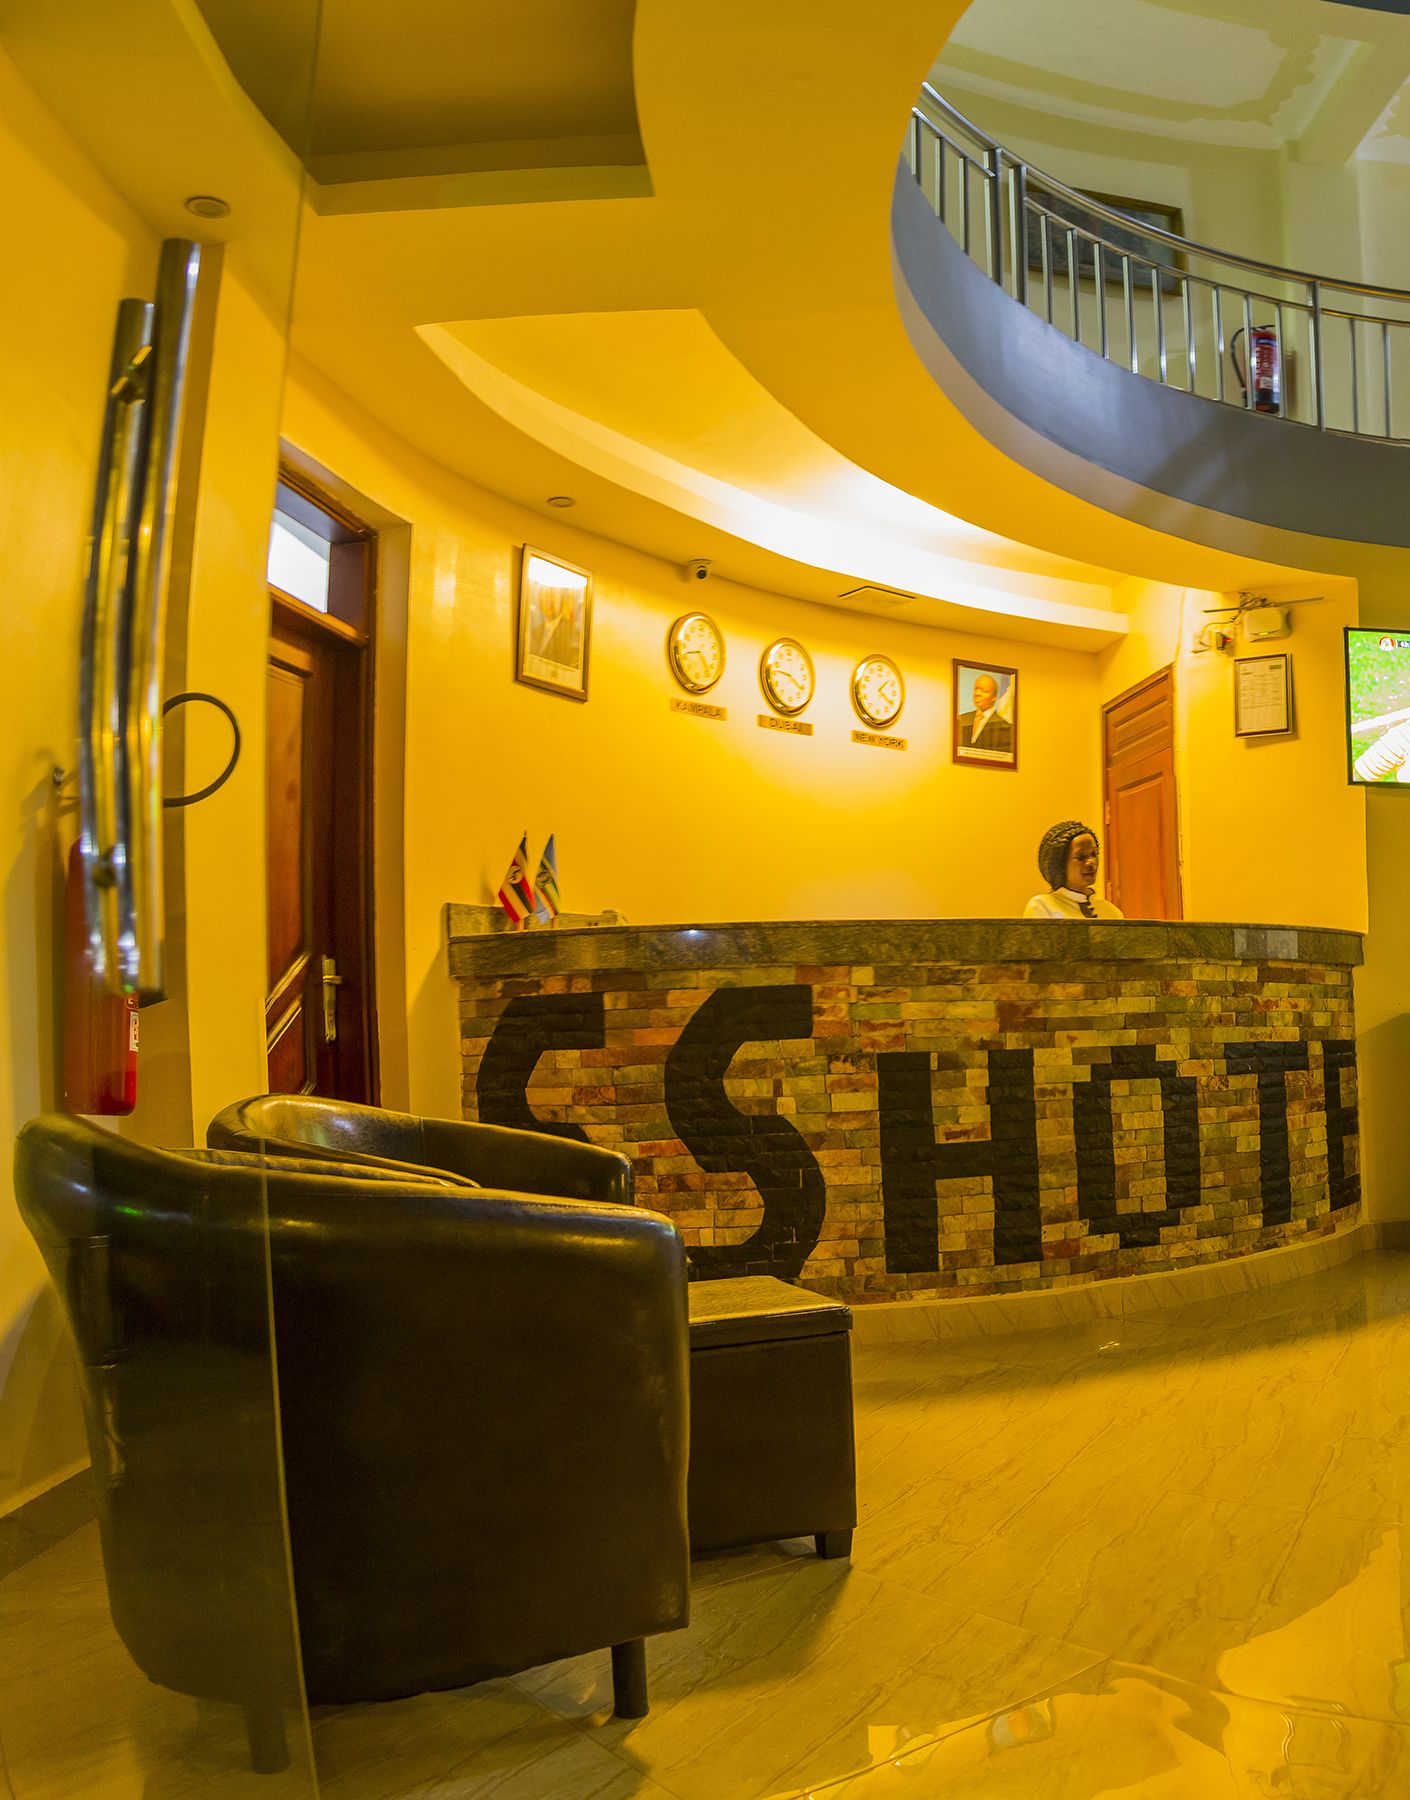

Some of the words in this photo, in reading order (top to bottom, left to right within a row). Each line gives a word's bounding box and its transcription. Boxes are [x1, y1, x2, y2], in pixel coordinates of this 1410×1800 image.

[676, 701, 721, 717] KAMPALA
[768, 717, 803, 733] DUBAI
[855, 732, 875, 743] NEW
[878, 736, 905, 748] YORK
